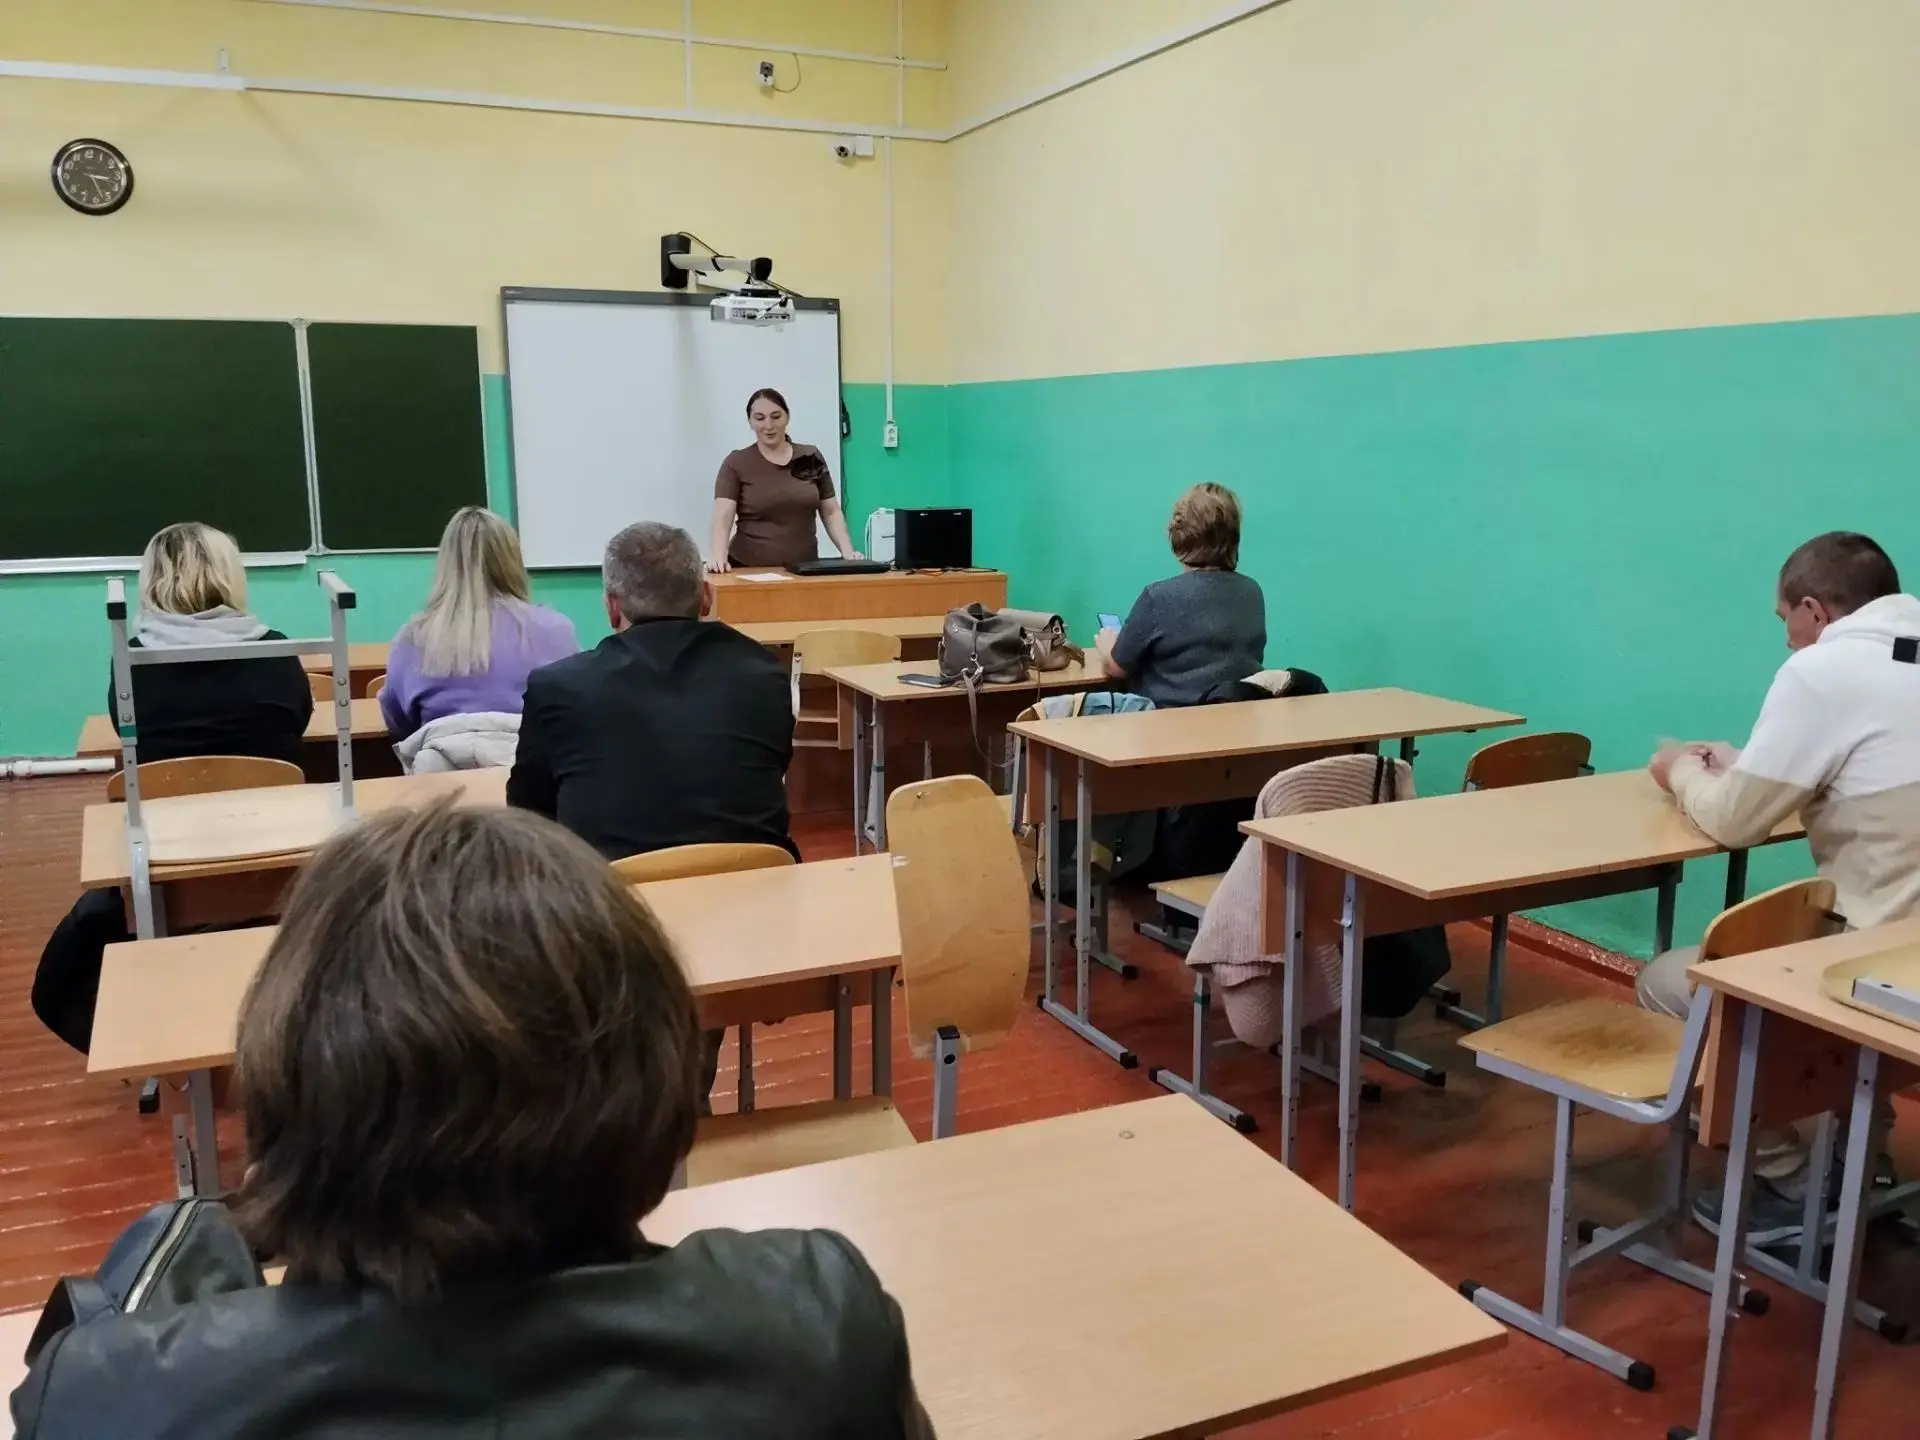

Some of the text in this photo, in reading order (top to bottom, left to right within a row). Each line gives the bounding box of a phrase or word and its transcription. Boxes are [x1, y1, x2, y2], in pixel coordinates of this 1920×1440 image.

[108, 158, 116, 169] 2
[114, 171, 121, 180] 3
[70, 184, 77, 193] 8
[92, 196, 100, 204] 6
